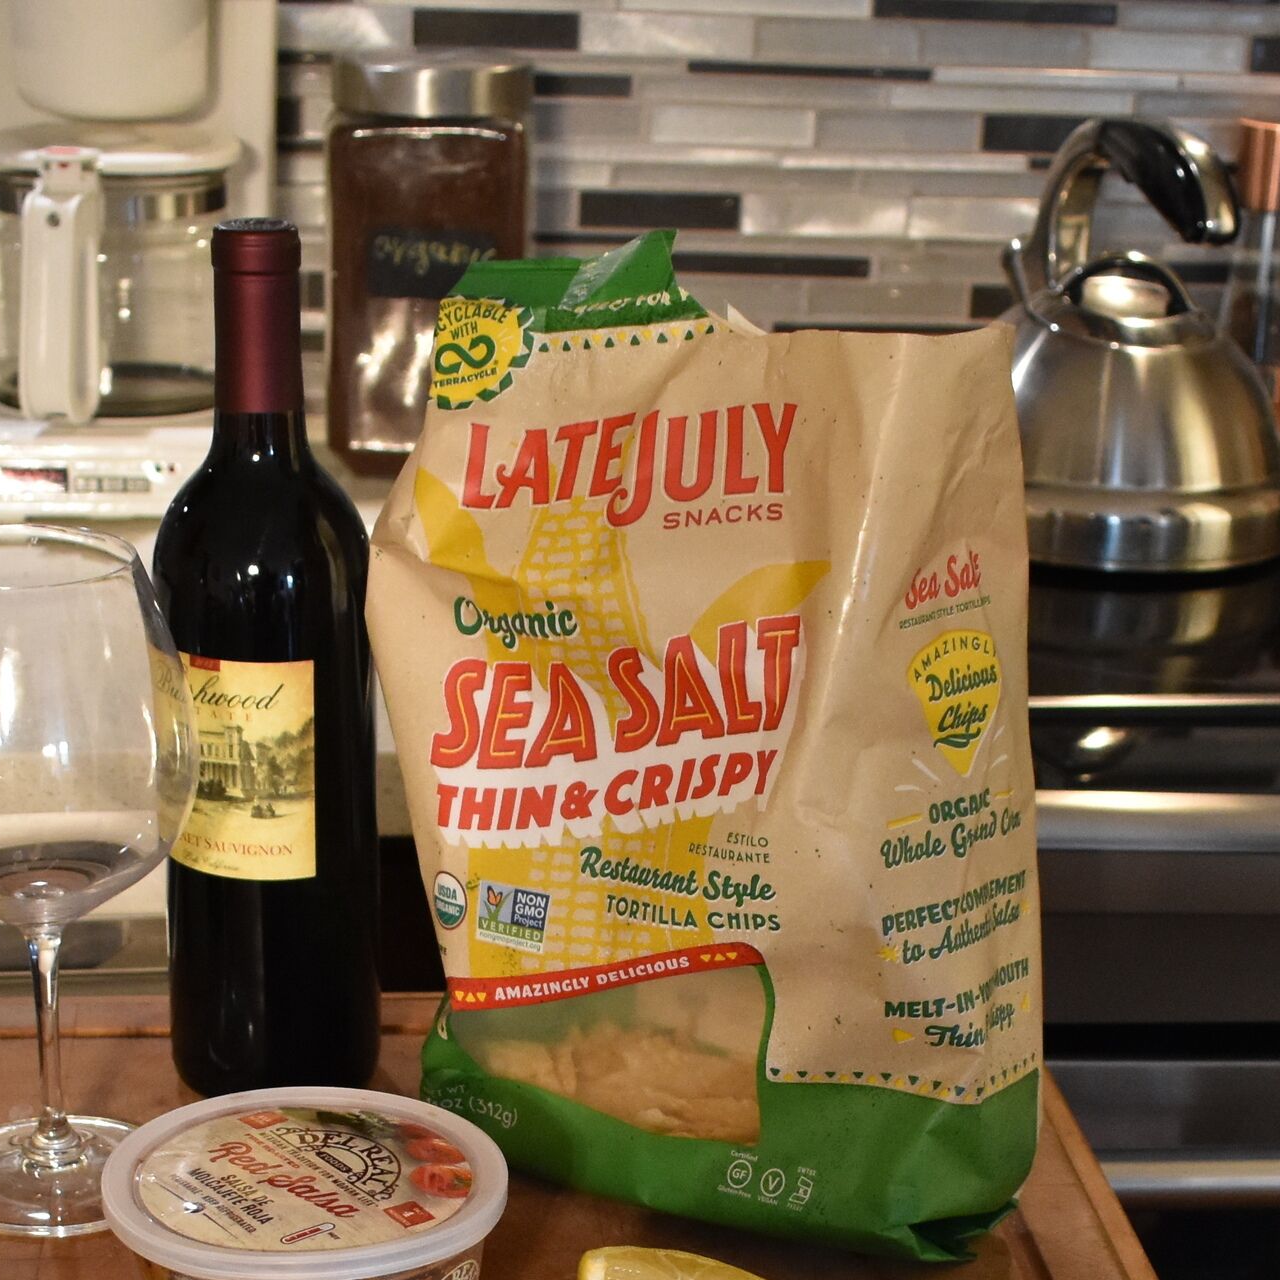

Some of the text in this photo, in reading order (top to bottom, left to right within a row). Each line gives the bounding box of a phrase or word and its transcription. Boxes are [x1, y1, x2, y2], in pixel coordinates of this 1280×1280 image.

[434, 304, 512, 338] CYCLABLE
[450, 321, 478, 341] WITH
[433, 367, 498, 389] TERRACYCLE
[461, 403, 798, 528] LATE JULY
[662, 503, 784, 531] SNACKS
[905, 567, 940, 611] Sea
[454, 596, 578, 650] Organic
[431, 615, 800, 769] SEA SALT
[925, 663, 998, 702] Delicious
[938, 701, 988, 733] Chips
[437, 749, 777, 831] THIN & CRISPY
[928, 788, 991, 824] ORGAIC
[204, 834, 293, 857] SAUVIGNON
[689, 842, 770, 863] RESTAURANTE
[727, 832, 769, 848] ESTILO
[880, 830, 946, 869] Whole
[950, 810, 997, 859] Grund
[437, 883, 458, 901] USDA
[580, 846, 777, 907] Restaurant Style
[515, 905, 545, 919] GMO
[517, 892, 547, 908] NON
[607, 894, 781, 931] TORTILLA CHIPS
[481, 919, 541, 941] VERIFIED
[513, 914, 543, 928] Project
[881, 896, 961, 937] PERFECT
[902, 940, 925, 965] to
[928, 912, 992, 960] Authenti
[495, 956, 690, 1001] AMAZINGLY DELICIOUS
[924, 1022, 985, 1048] Thin
[469, 1096, 518, 1128] (312g)
[297, 1131, 359, 1149] DEL
[319, 1153, 349, 1173] FOODS
[732, 1168, 748, 1180] GF
[208, 1141, 281, 1177] Red
[256, 1174, 360, 1219] Salsa
[220, 1173, 275, 1206] SALSA DE
[332, 1177, 360, 1198] MODERN
[189, 1168, 275, 1225] MOLCAJETE ROJA
